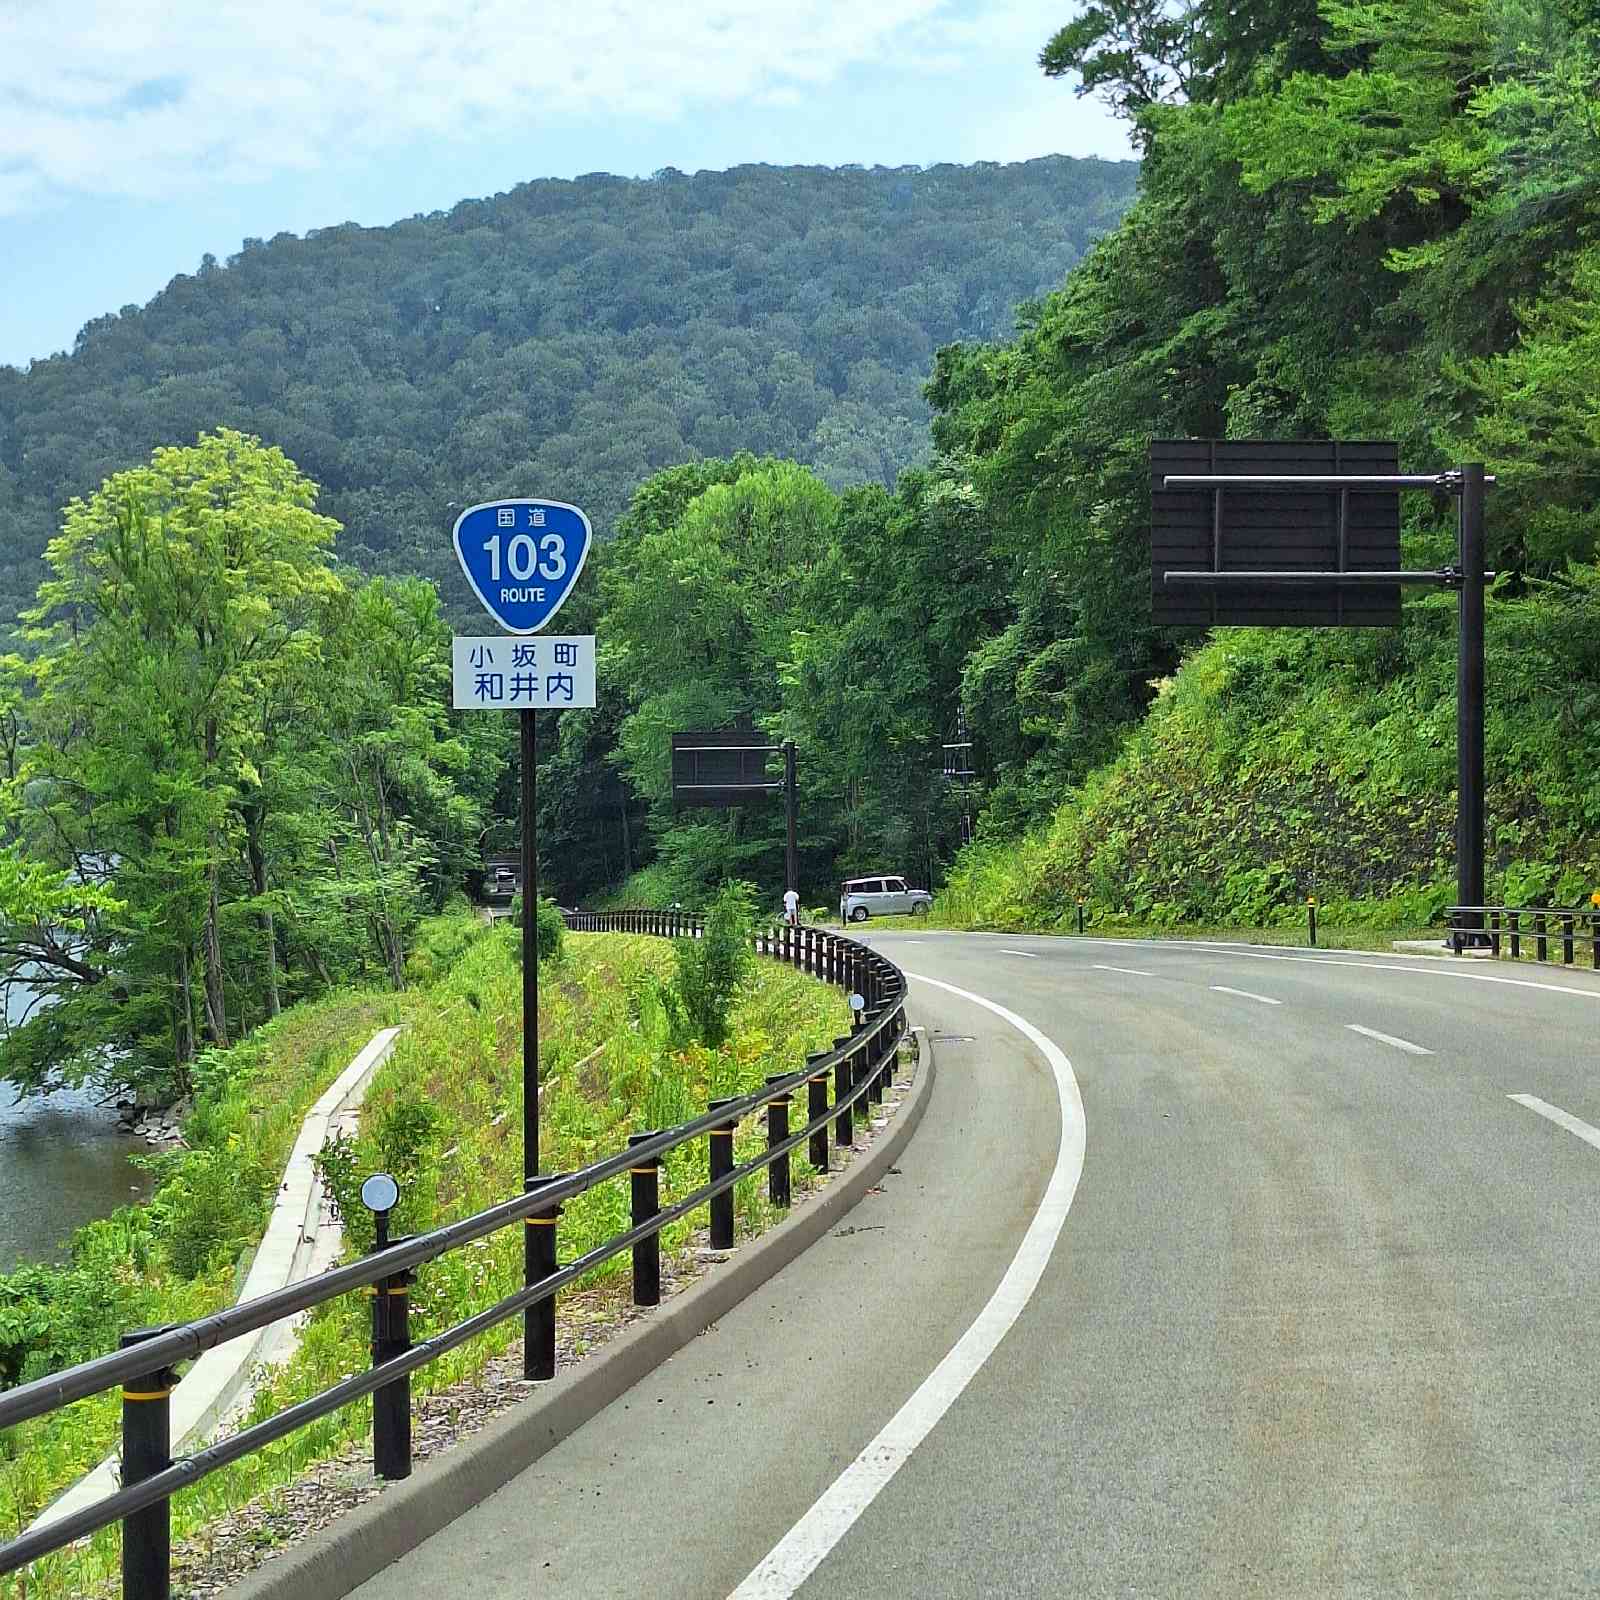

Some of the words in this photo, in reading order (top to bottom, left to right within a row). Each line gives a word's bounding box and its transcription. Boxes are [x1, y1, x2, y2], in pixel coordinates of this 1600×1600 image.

[498, 508, 546, 527] 国道
[483, 534, 566, 581] 103
[500, 587, 545, 603] ROUTE
[470, 643, 579, 668] 小坂町
[474, 672, 573, 702] 和井内
